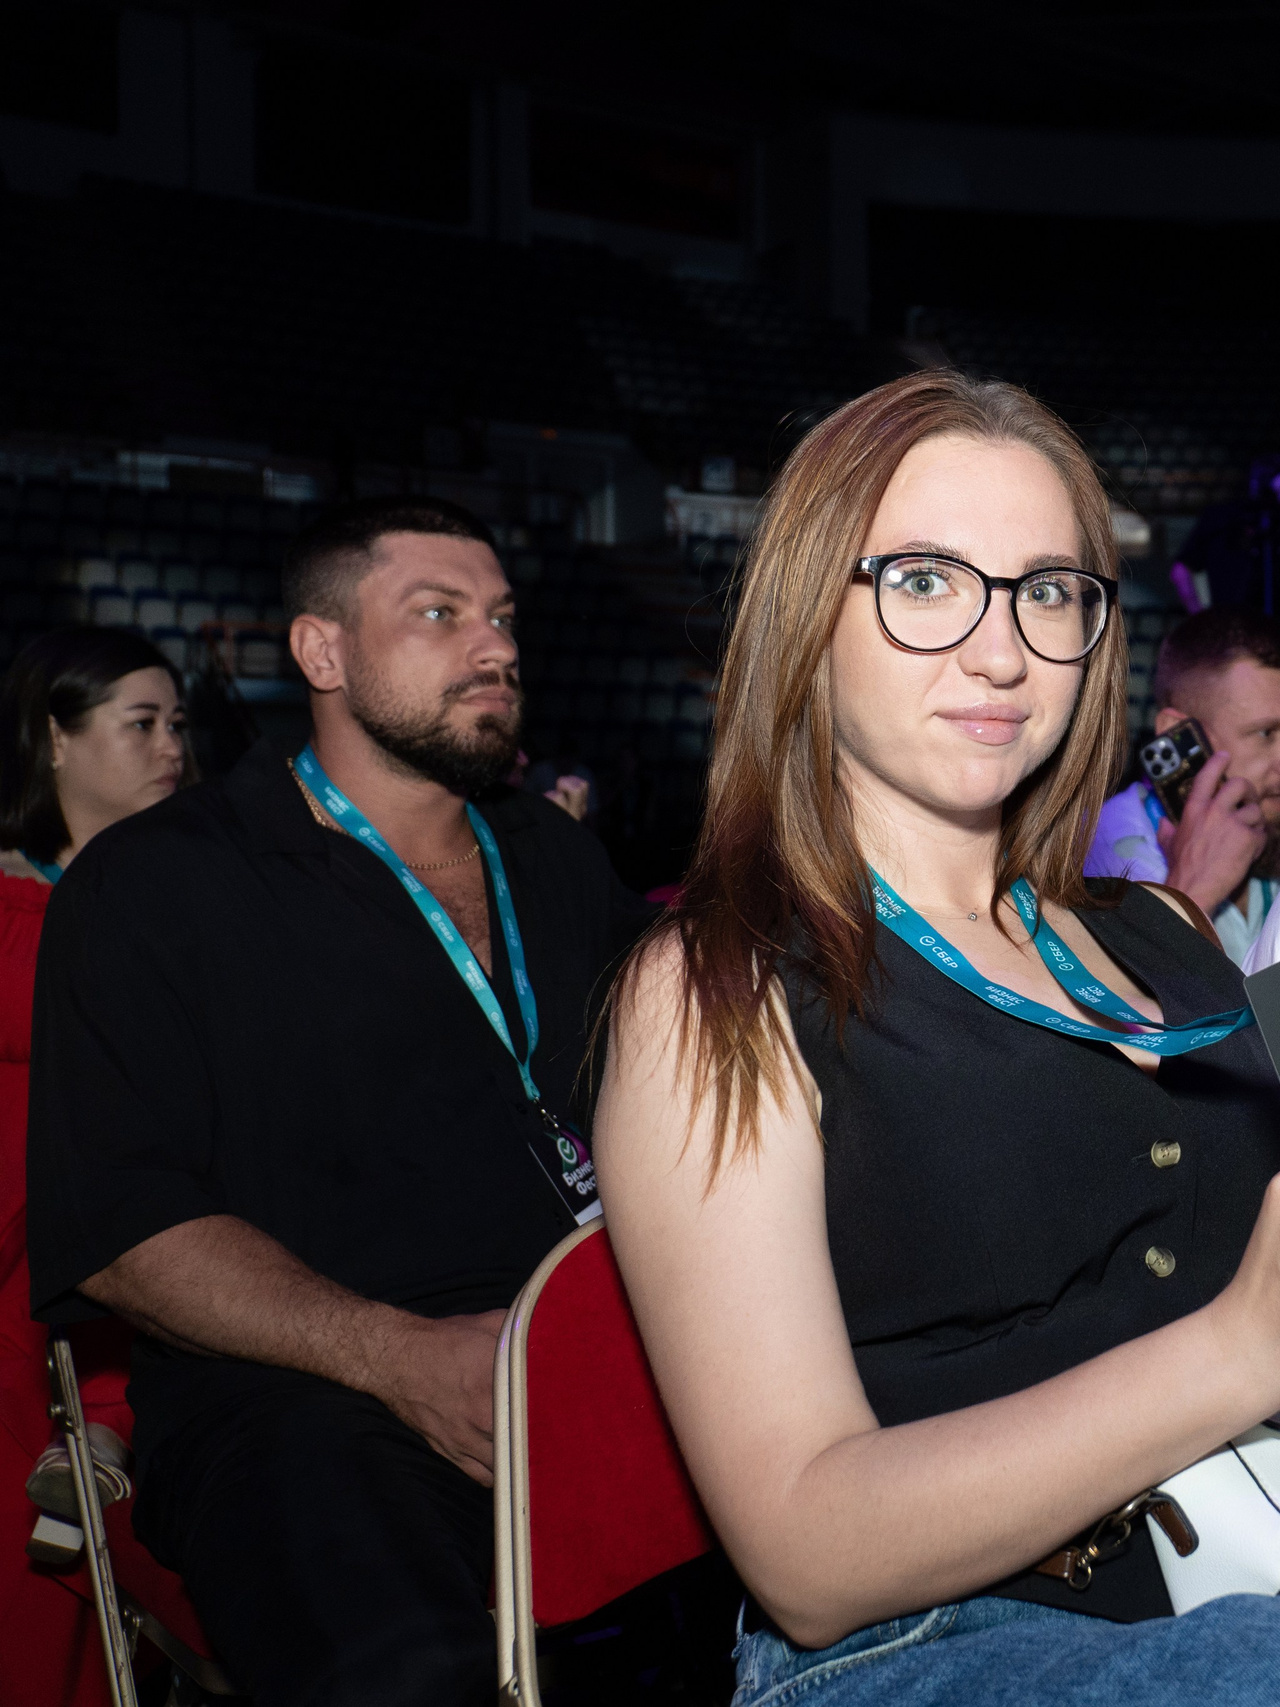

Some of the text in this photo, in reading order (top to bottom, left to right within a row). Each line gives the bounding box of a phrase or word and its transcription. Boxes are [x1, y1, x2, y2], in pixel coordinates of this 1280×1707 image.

[872, 886, 907, 915] БИЗНЕС
[932, 946, 959, 969] СБЕР
[1047, 941, 1066, 962] СБЕР
[985, 985, 1025, 1005] БИЗНЕС
[988, 994, 1017, 1008] ФЕСТ
[576, 1175, 596, 1195] Фес
